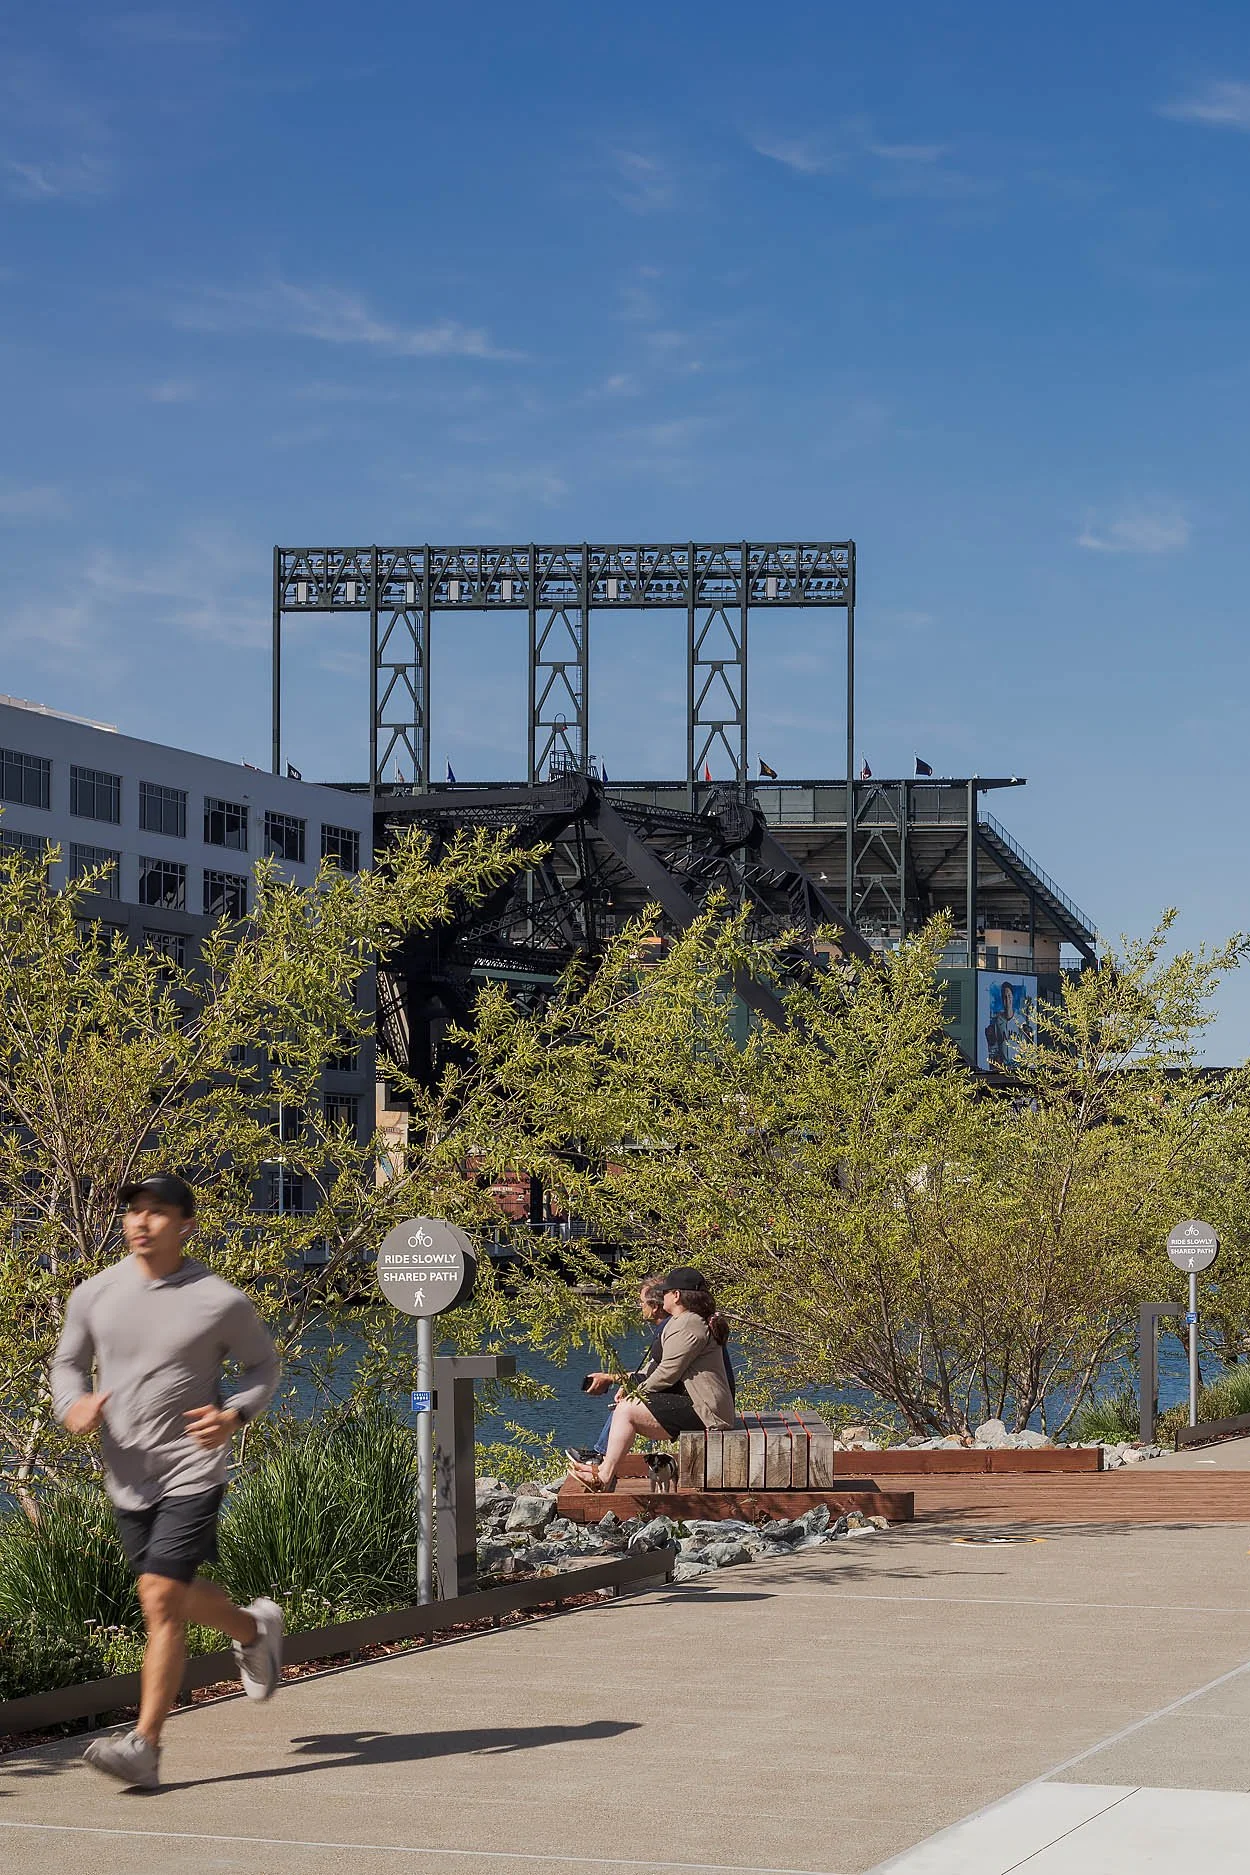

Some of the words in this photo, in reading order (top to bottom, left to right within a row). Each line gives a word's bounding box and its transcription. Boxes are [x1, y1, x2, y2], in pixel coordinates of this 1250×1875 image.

[384, 1254, 410, 1264] RIDE
[411, 1254, 457, 1264] SLOWLY
[383, 1272, 427, 1282] SHARED
[429, 1271, 458, 1281] PATH
